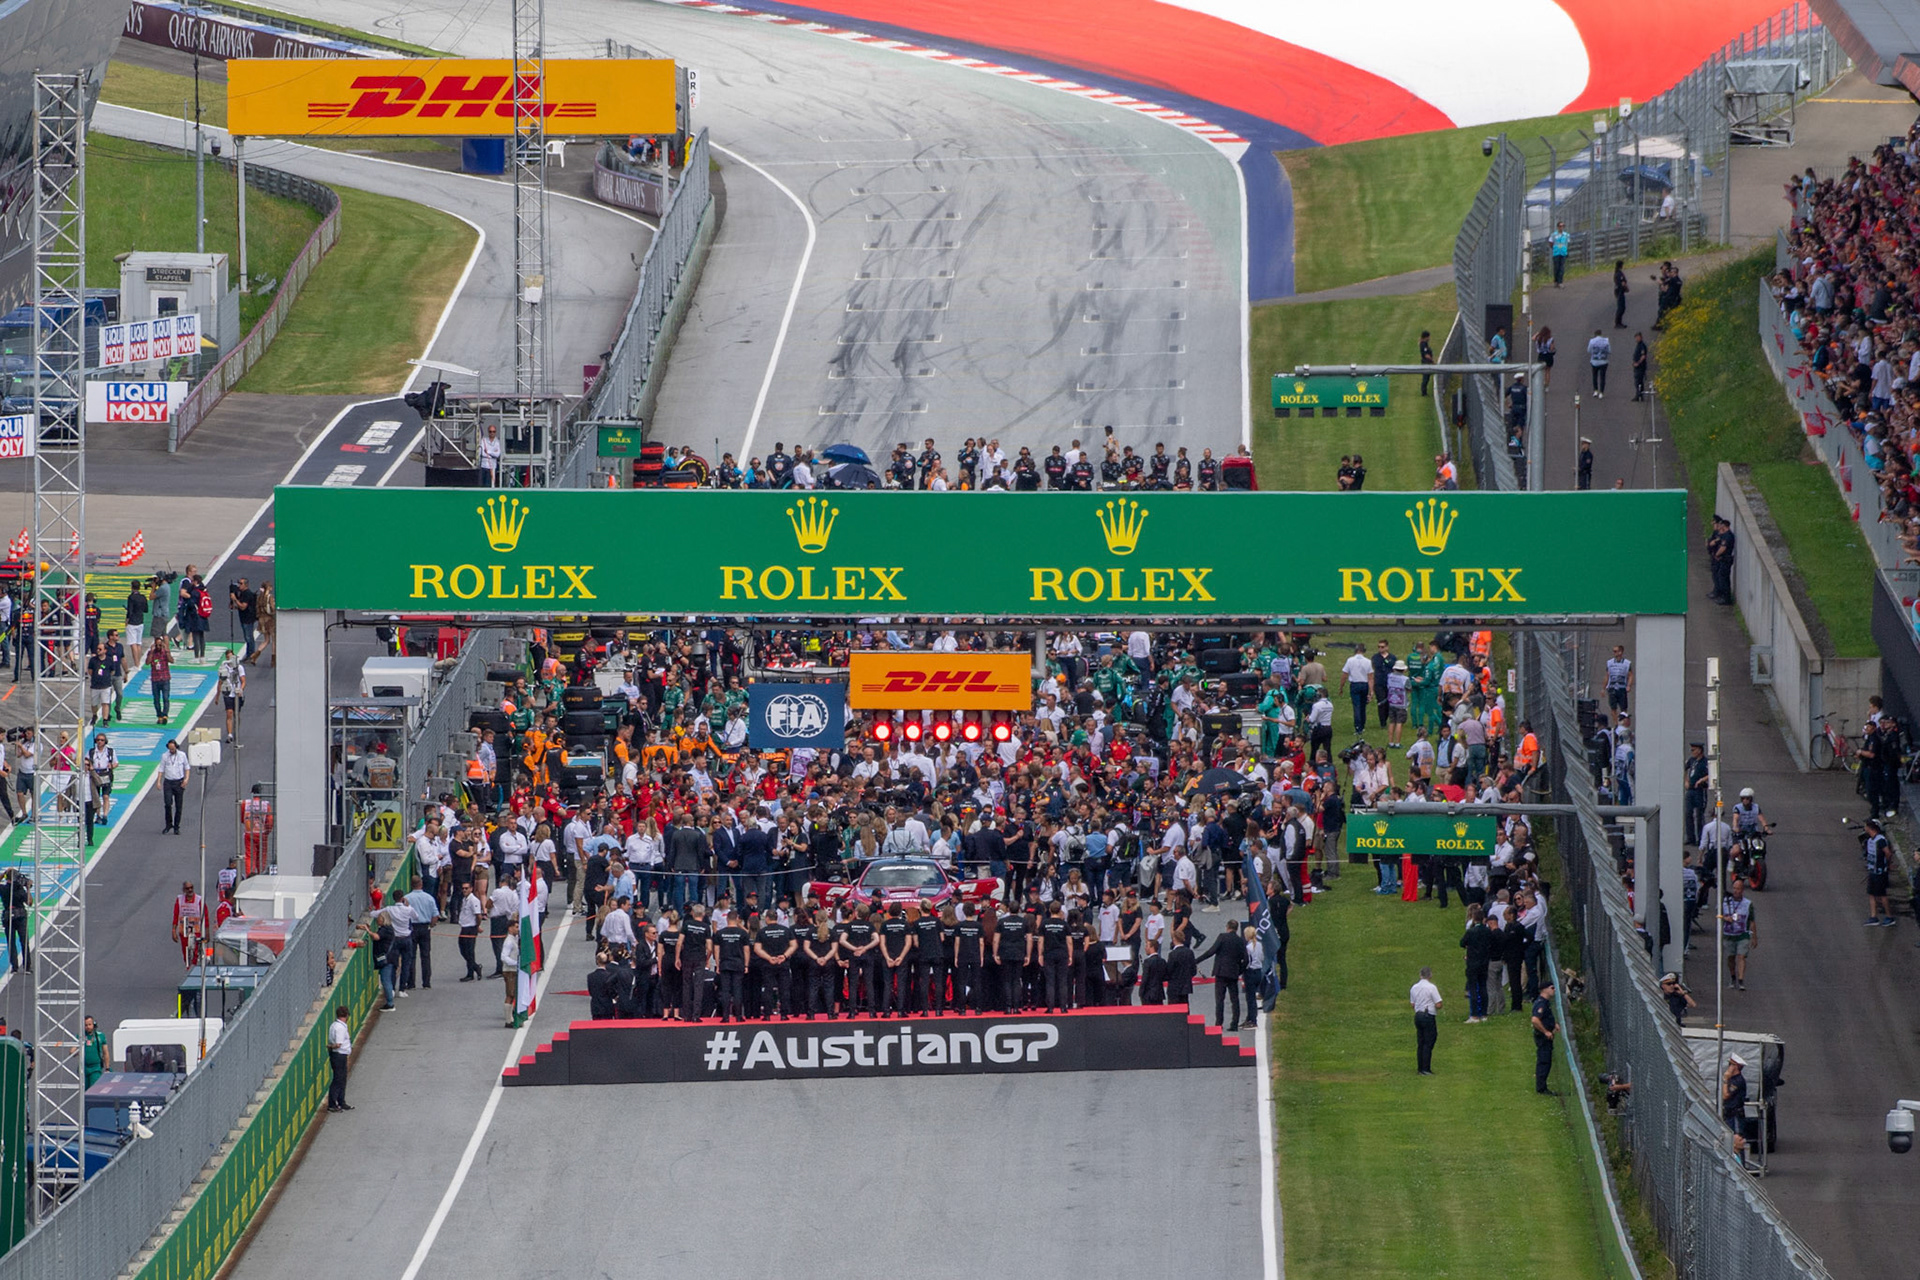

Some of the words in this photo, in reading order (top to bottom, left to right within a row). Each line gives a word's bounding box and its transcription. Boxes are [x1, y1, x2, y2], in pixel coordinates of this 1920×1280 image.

[168, 13, 207, 52] QATAR
[208, 23, 255, 58] AIRWAYS
[346, 76, 557, 118] DHL
[130, 343, 148, 360] MOLY
[155, 339, 171, 356] MOLY
[177, 336, 195, 352] MOLY
[106, 346, 124, 363] MOLY
[109, 385, 165, 402] LIQUI
[1280, 395, 1319, 404] ROLEX
[1343, 394, 1381, 403] ROLEX
[109, 404, 166, 420] MOLY
[409, 564, 597, 600] ROLEX
[719, 565, 907, 601] ROLEX
[1029, 567, 1216, 602] ROLEX
[1338, 567, 1526, 602] ROLEX
[883, 671, 998, 692] DHL
[1356, 837, 1405, 848] ROLEX
[1436, 839, 1485, 850] ROLEX
[703, 1024, 1059, 1071] #AustrianGP
